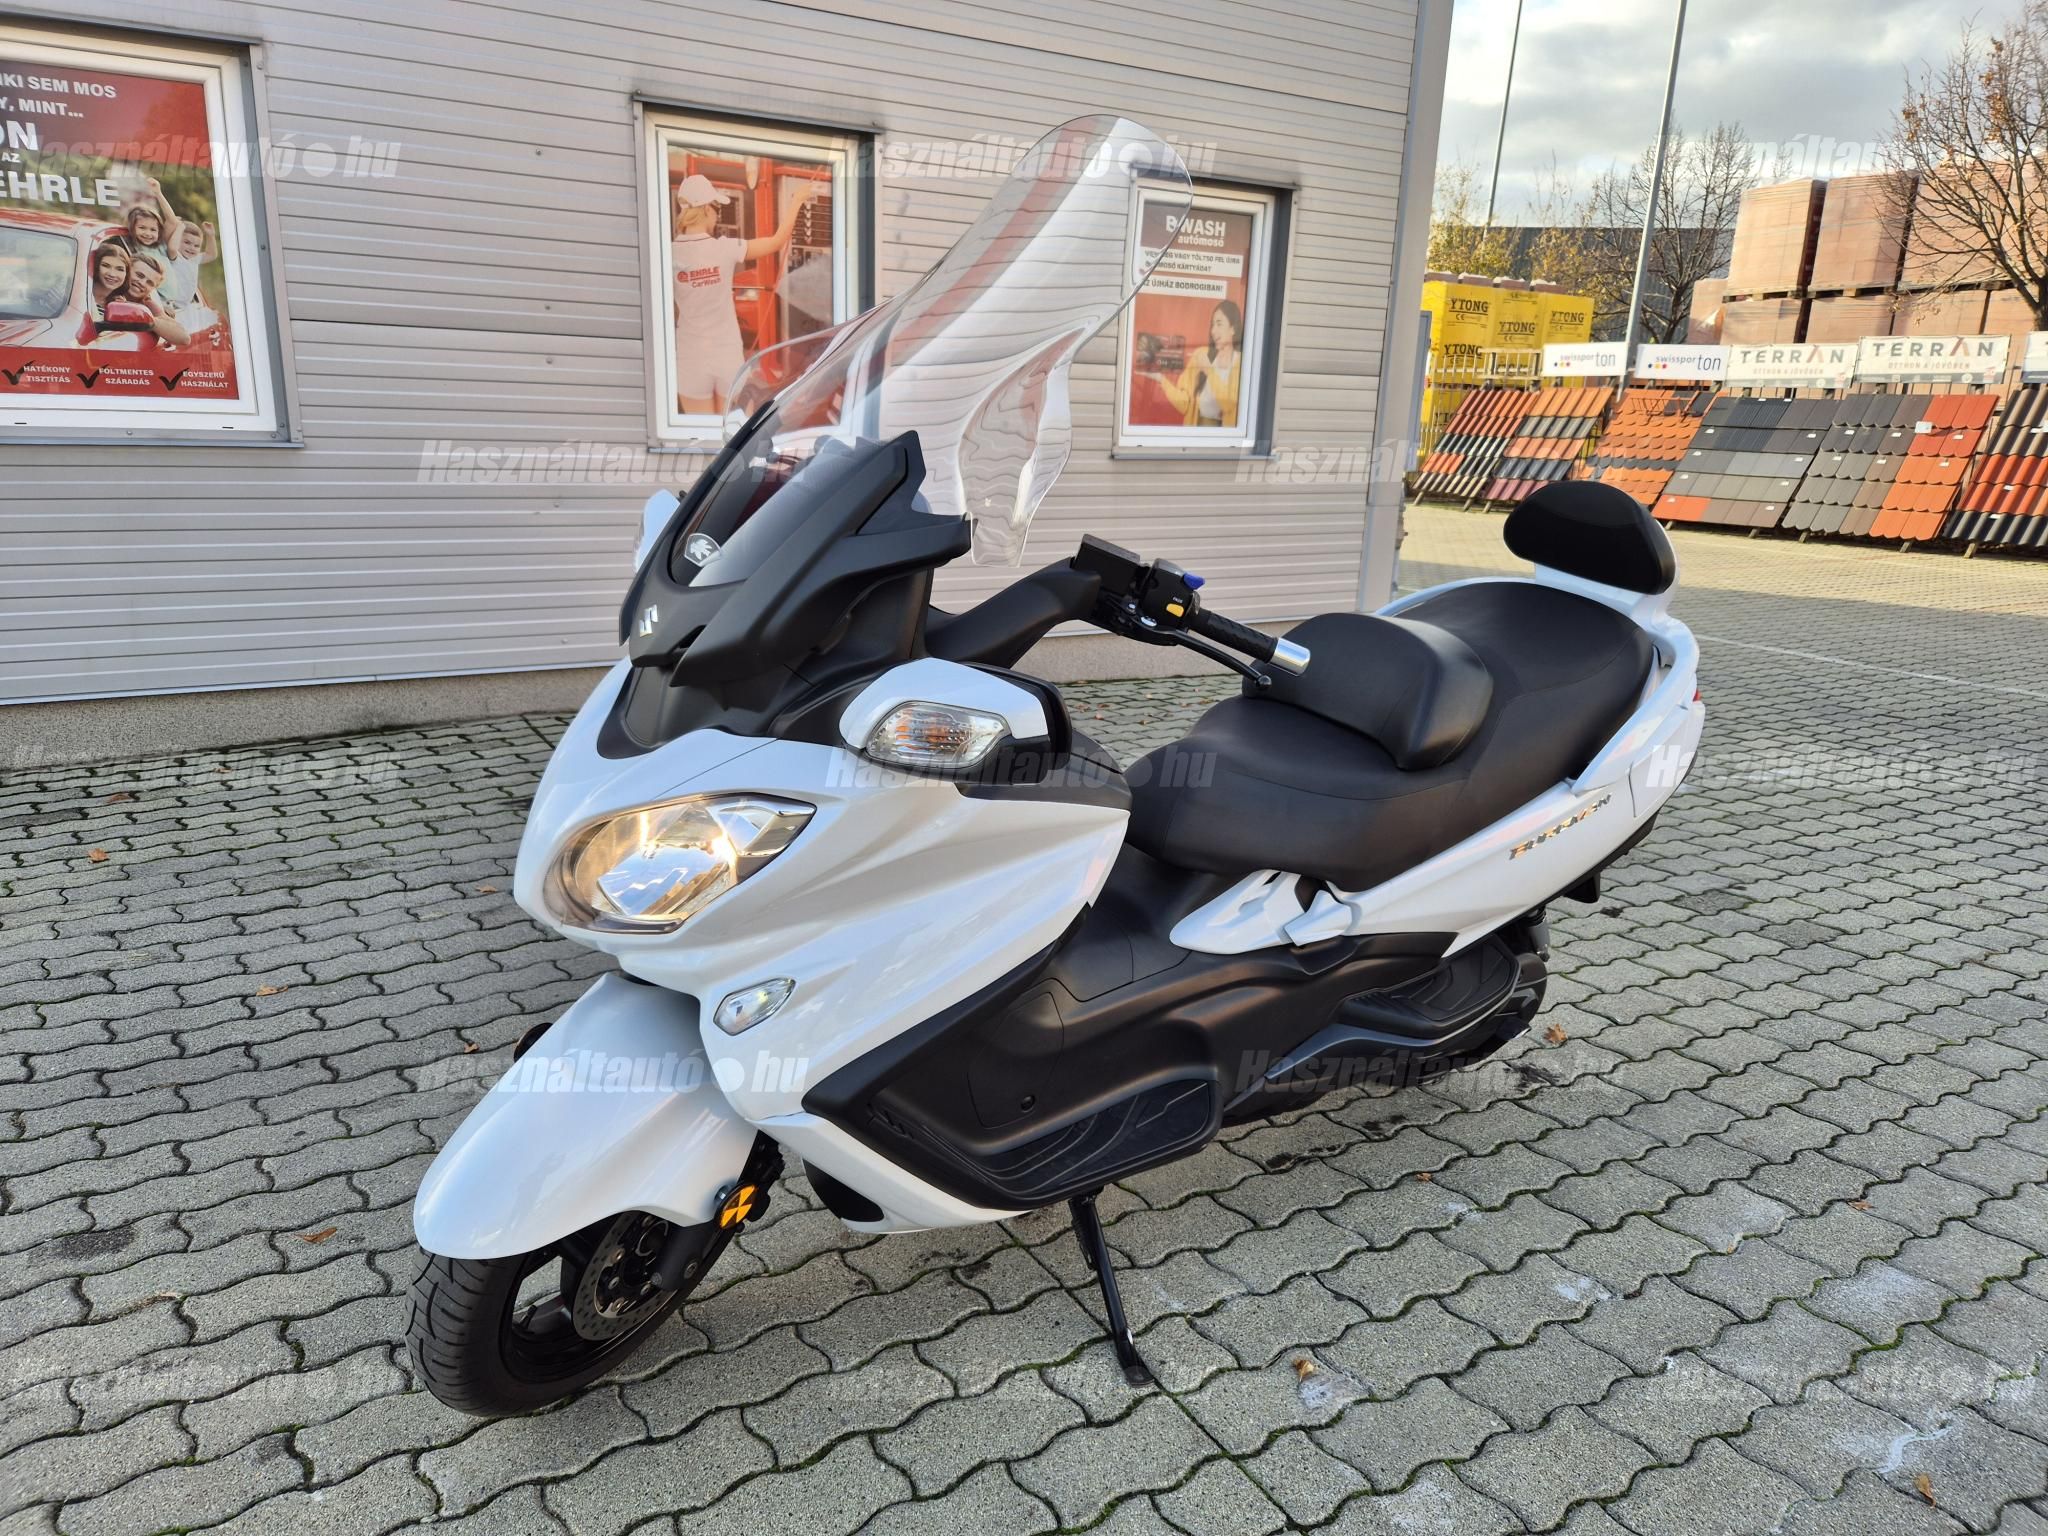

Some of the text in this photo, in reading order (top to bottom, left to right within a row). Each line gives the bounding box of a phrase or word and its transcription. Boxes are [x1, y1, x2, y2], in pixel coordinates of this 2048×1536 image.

[0, 73, 117, 98] KI SEM MOS
[0, 120, 39, 151] N
[2, 151, 21, 163] AZ
[1450, 298, 1489, 313] YTONG
[1551, 310, 1585, 323] YTONG
[1499, 321, 1536, 334] YTONG
[23, 364, 71, 374] HATÉKONY
[26, 375, 72, 383] TISZTÍTÁS
[105, 377, 150, 386] SZÁRADÁS
[180, 379, 229, 389] HASZNÁLAT
